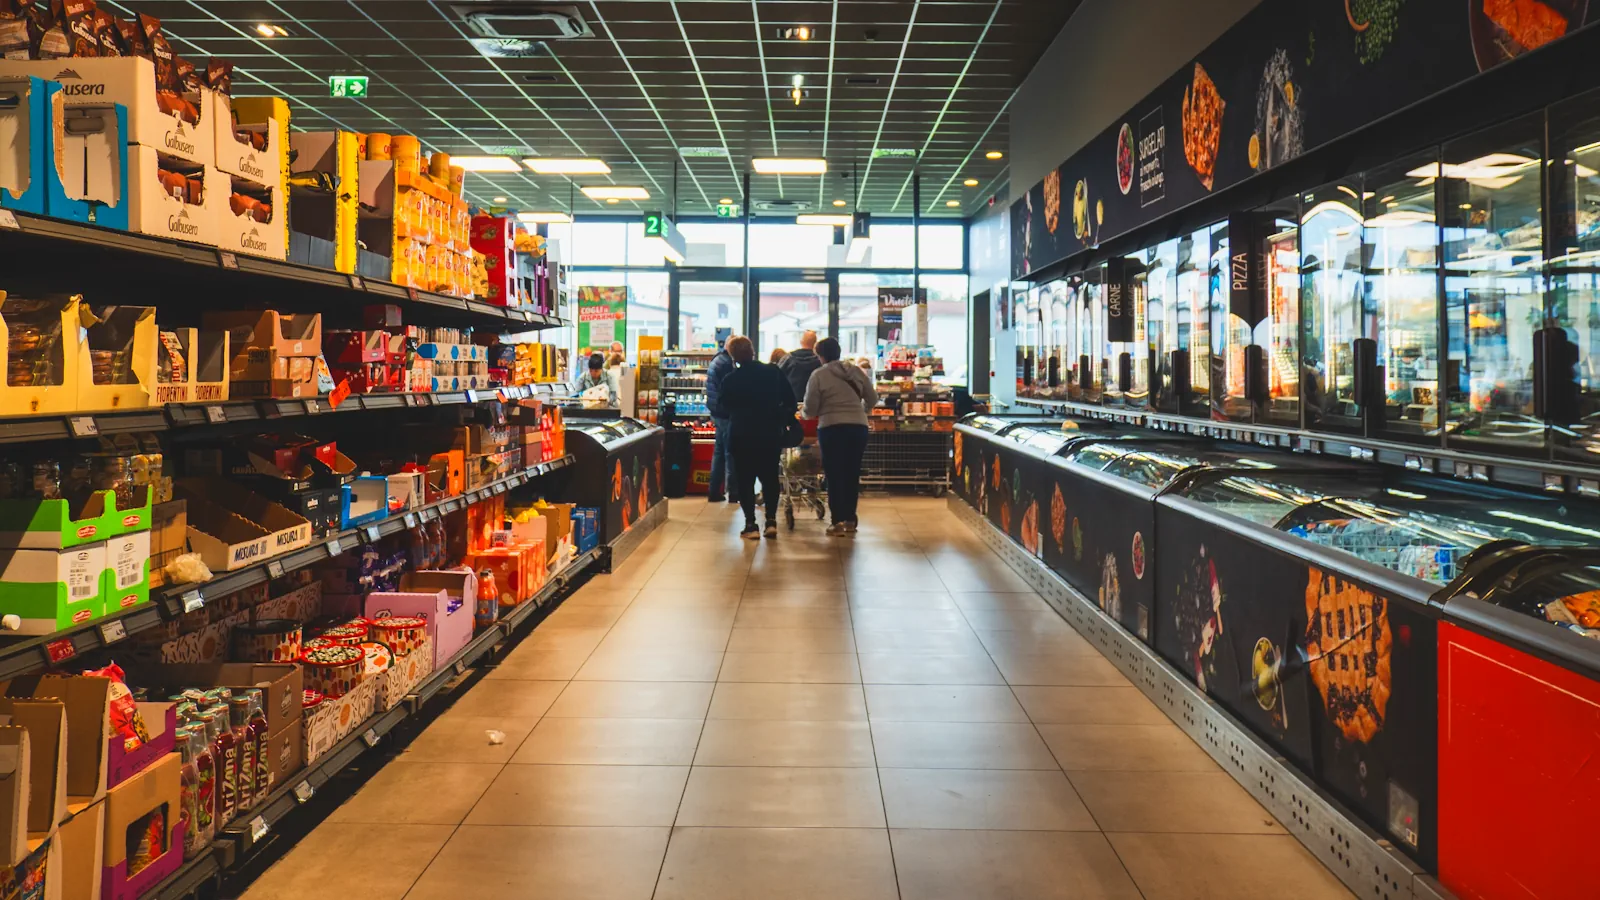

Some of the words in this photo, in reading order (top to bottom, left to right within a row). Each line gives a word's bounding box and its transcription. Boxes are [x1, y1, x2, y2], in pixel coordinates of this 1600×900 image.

[165, 131, 195, 155] Galbusera
[1139, 125, 1165, 161] SURGELATI
[239, 156, 264, 179] Galbusera
[168, 214, 198, 236] Galbusera
[647, 216, 658, 233] 2
[857, 218, 864, 233] 1
[240, 232, 267, 251] Galbusera
[1232, 252, 1248, 291] PIZZA
[1109, 283, 1121, 317] CARNE
[221, 748, 235, 822] AriZona
[238, 741, 252, 810] AriZona
